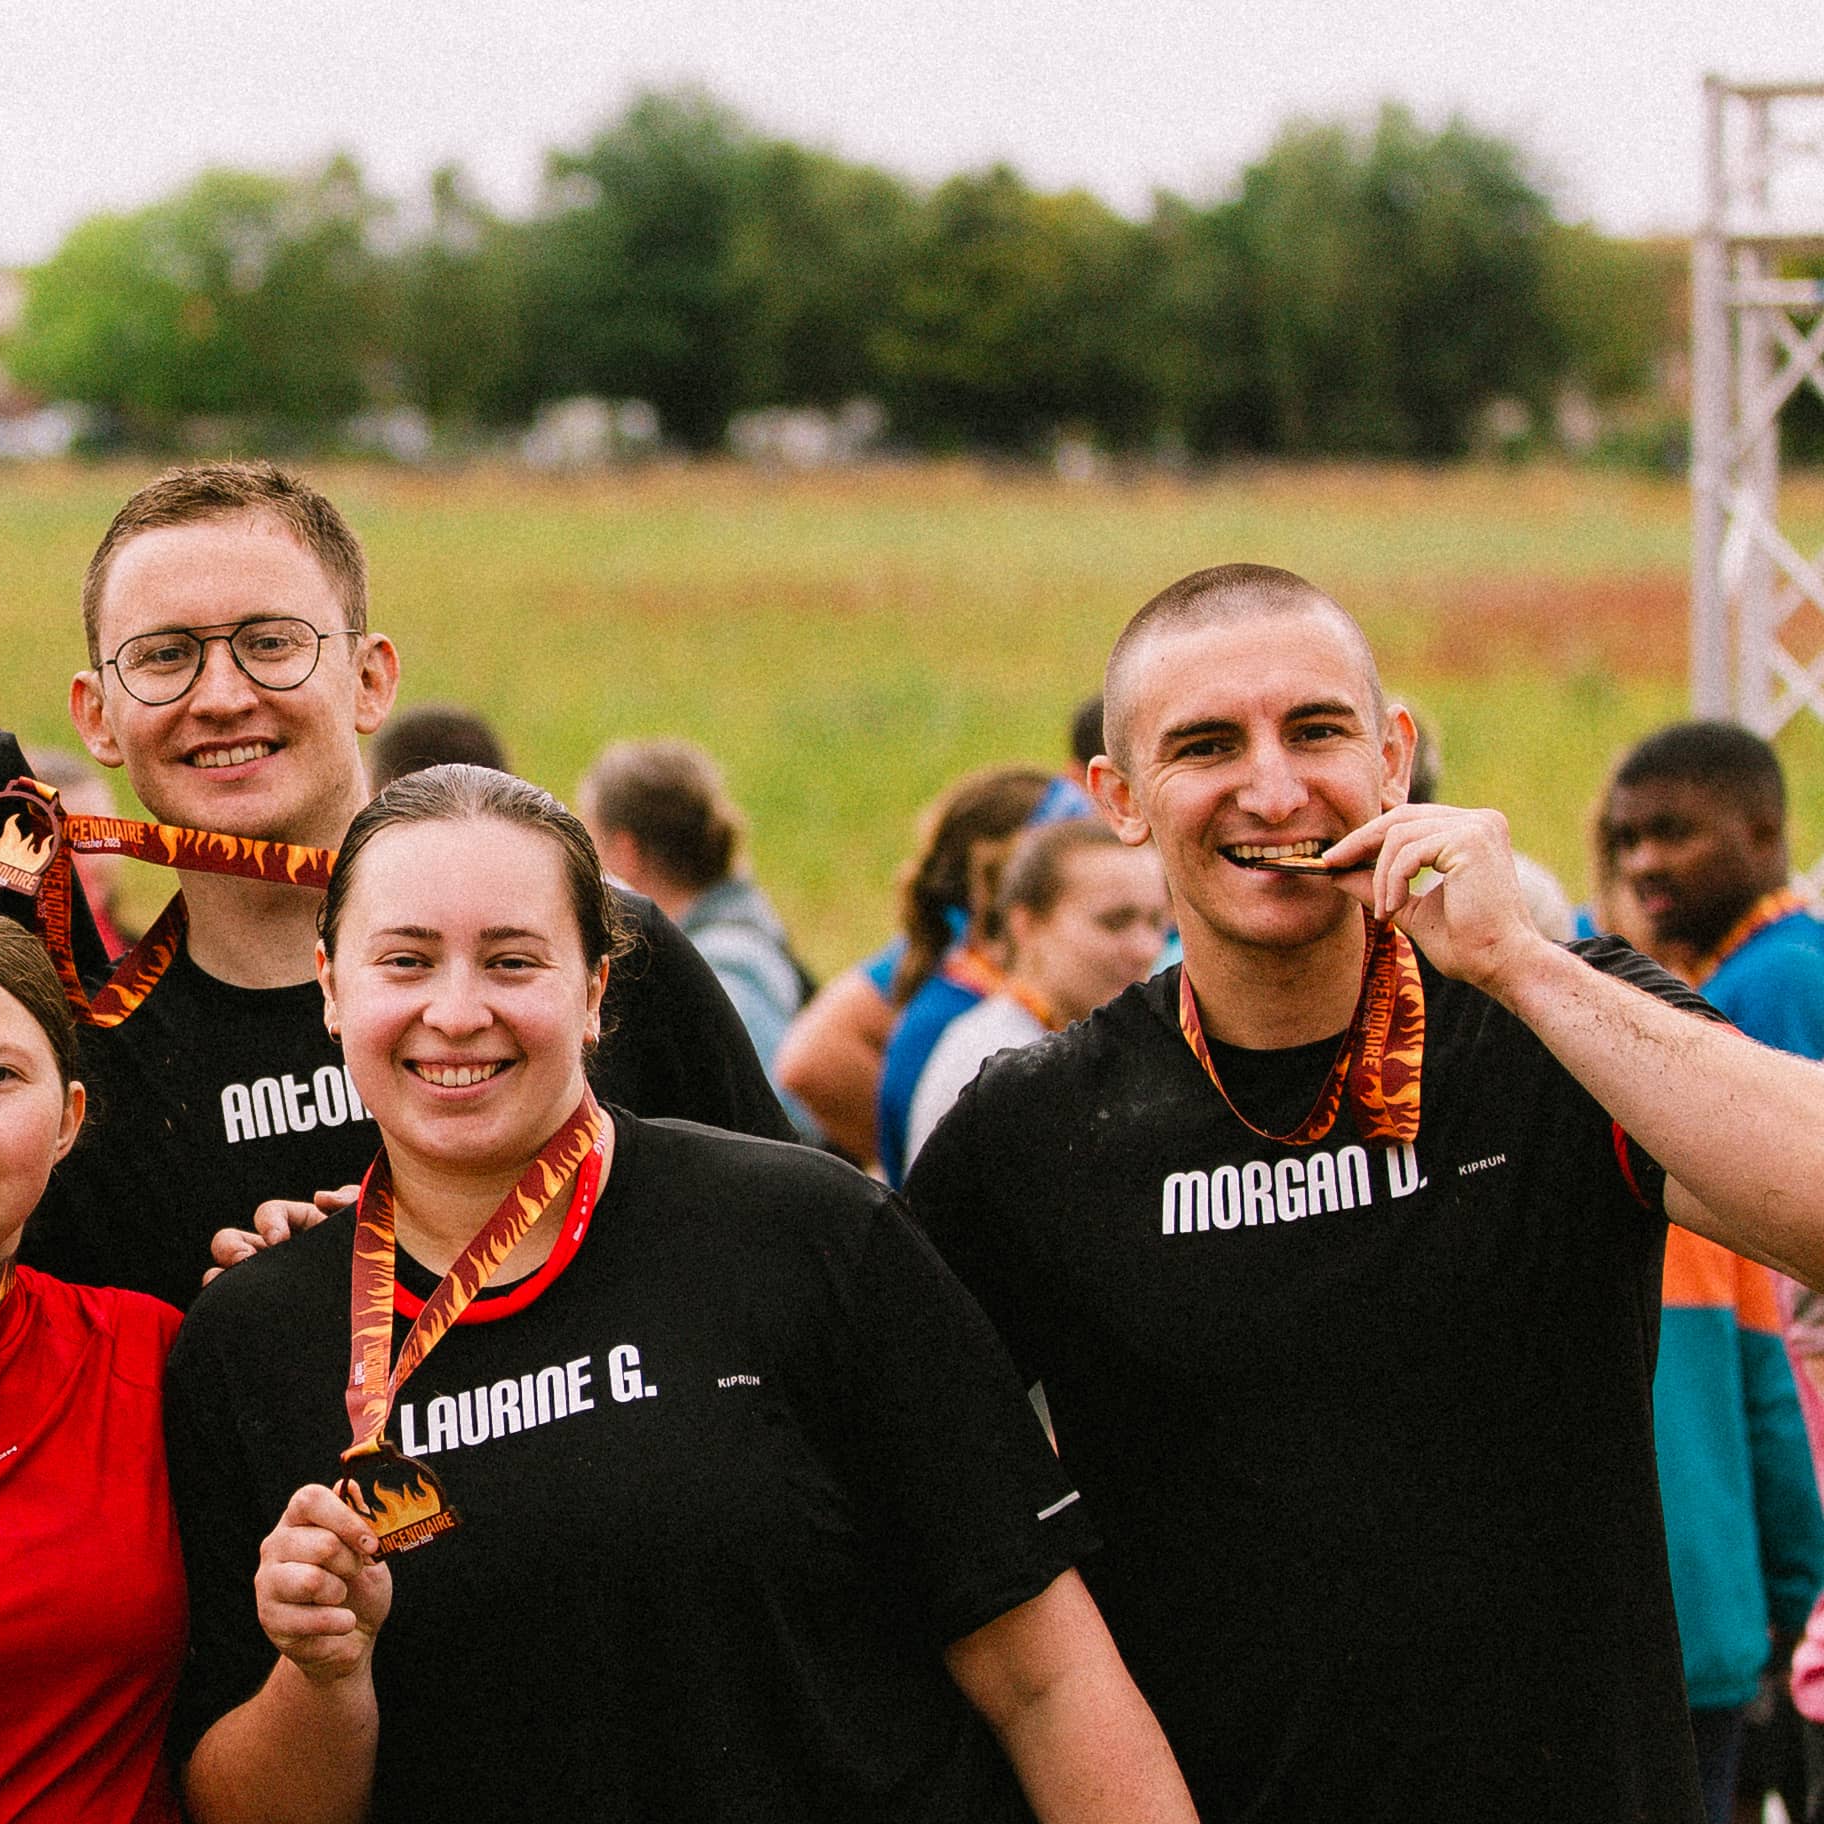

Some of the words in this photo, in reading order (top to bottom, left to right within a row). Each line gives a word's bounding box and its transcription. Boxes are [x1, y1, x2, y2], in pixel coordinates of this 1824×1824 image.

[1162, 1145, 1372, 1235] MORGAN
[1458, 1153, 1507, 1177] KIPRUN
[400, 1355, 594, 1458] LAURINE
[608, 1344, 658, 1403] G.
[717, 1374, 761, 1388] KIPRUN
